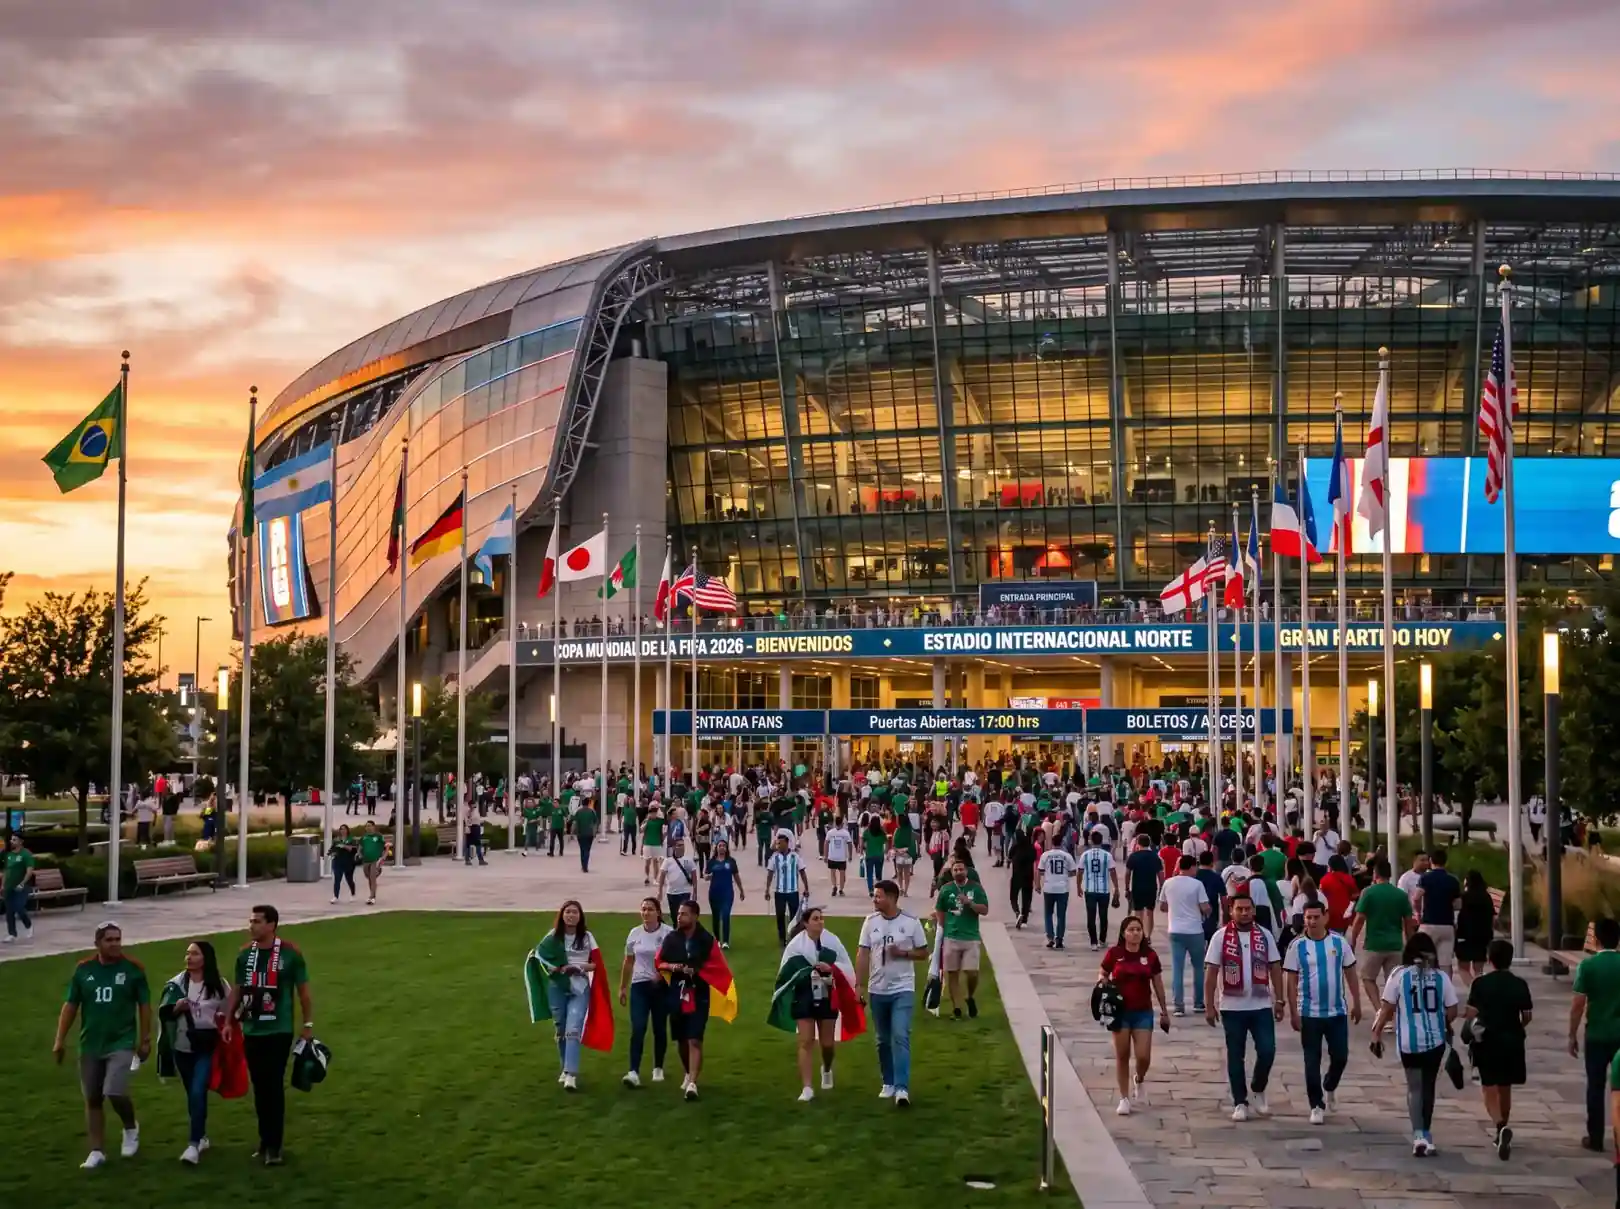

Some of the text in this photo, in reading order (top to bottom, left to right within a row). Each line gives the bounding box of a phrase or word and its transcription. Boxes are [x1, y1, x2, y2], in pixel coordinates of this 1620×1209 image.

[1000, 592, 1075, 602] ENTRADA PRINCIPAL
[923, 630, 1193, 651] ESTADIO INTERNACIONAL NORTE
[1279, 628, 1328, 646] GRAN
[1414, 628, 1452, 646] HOY
[586, 641, 641, 658] MUNDIAL
[641, 640, 658, 656] DE
[660, 639, 677, 655] LA
[679, 638, 708, 655] FIFA
[710, 637, 744, 654] 2026
[755, 635, 853, 653] BIENVENIDOS
[695, 715, 783, 729] ENTRADA FANS
[869, 715, 1040, 729] Puertas Abiertas: 17:00 hrs
[1126, 714, 1188, 729] BOLETOS
[1200, 714, 1255, 729] ACESO
[95, 986, 113, 1002] 10
[1410, 985, 1438, 1013] 10
